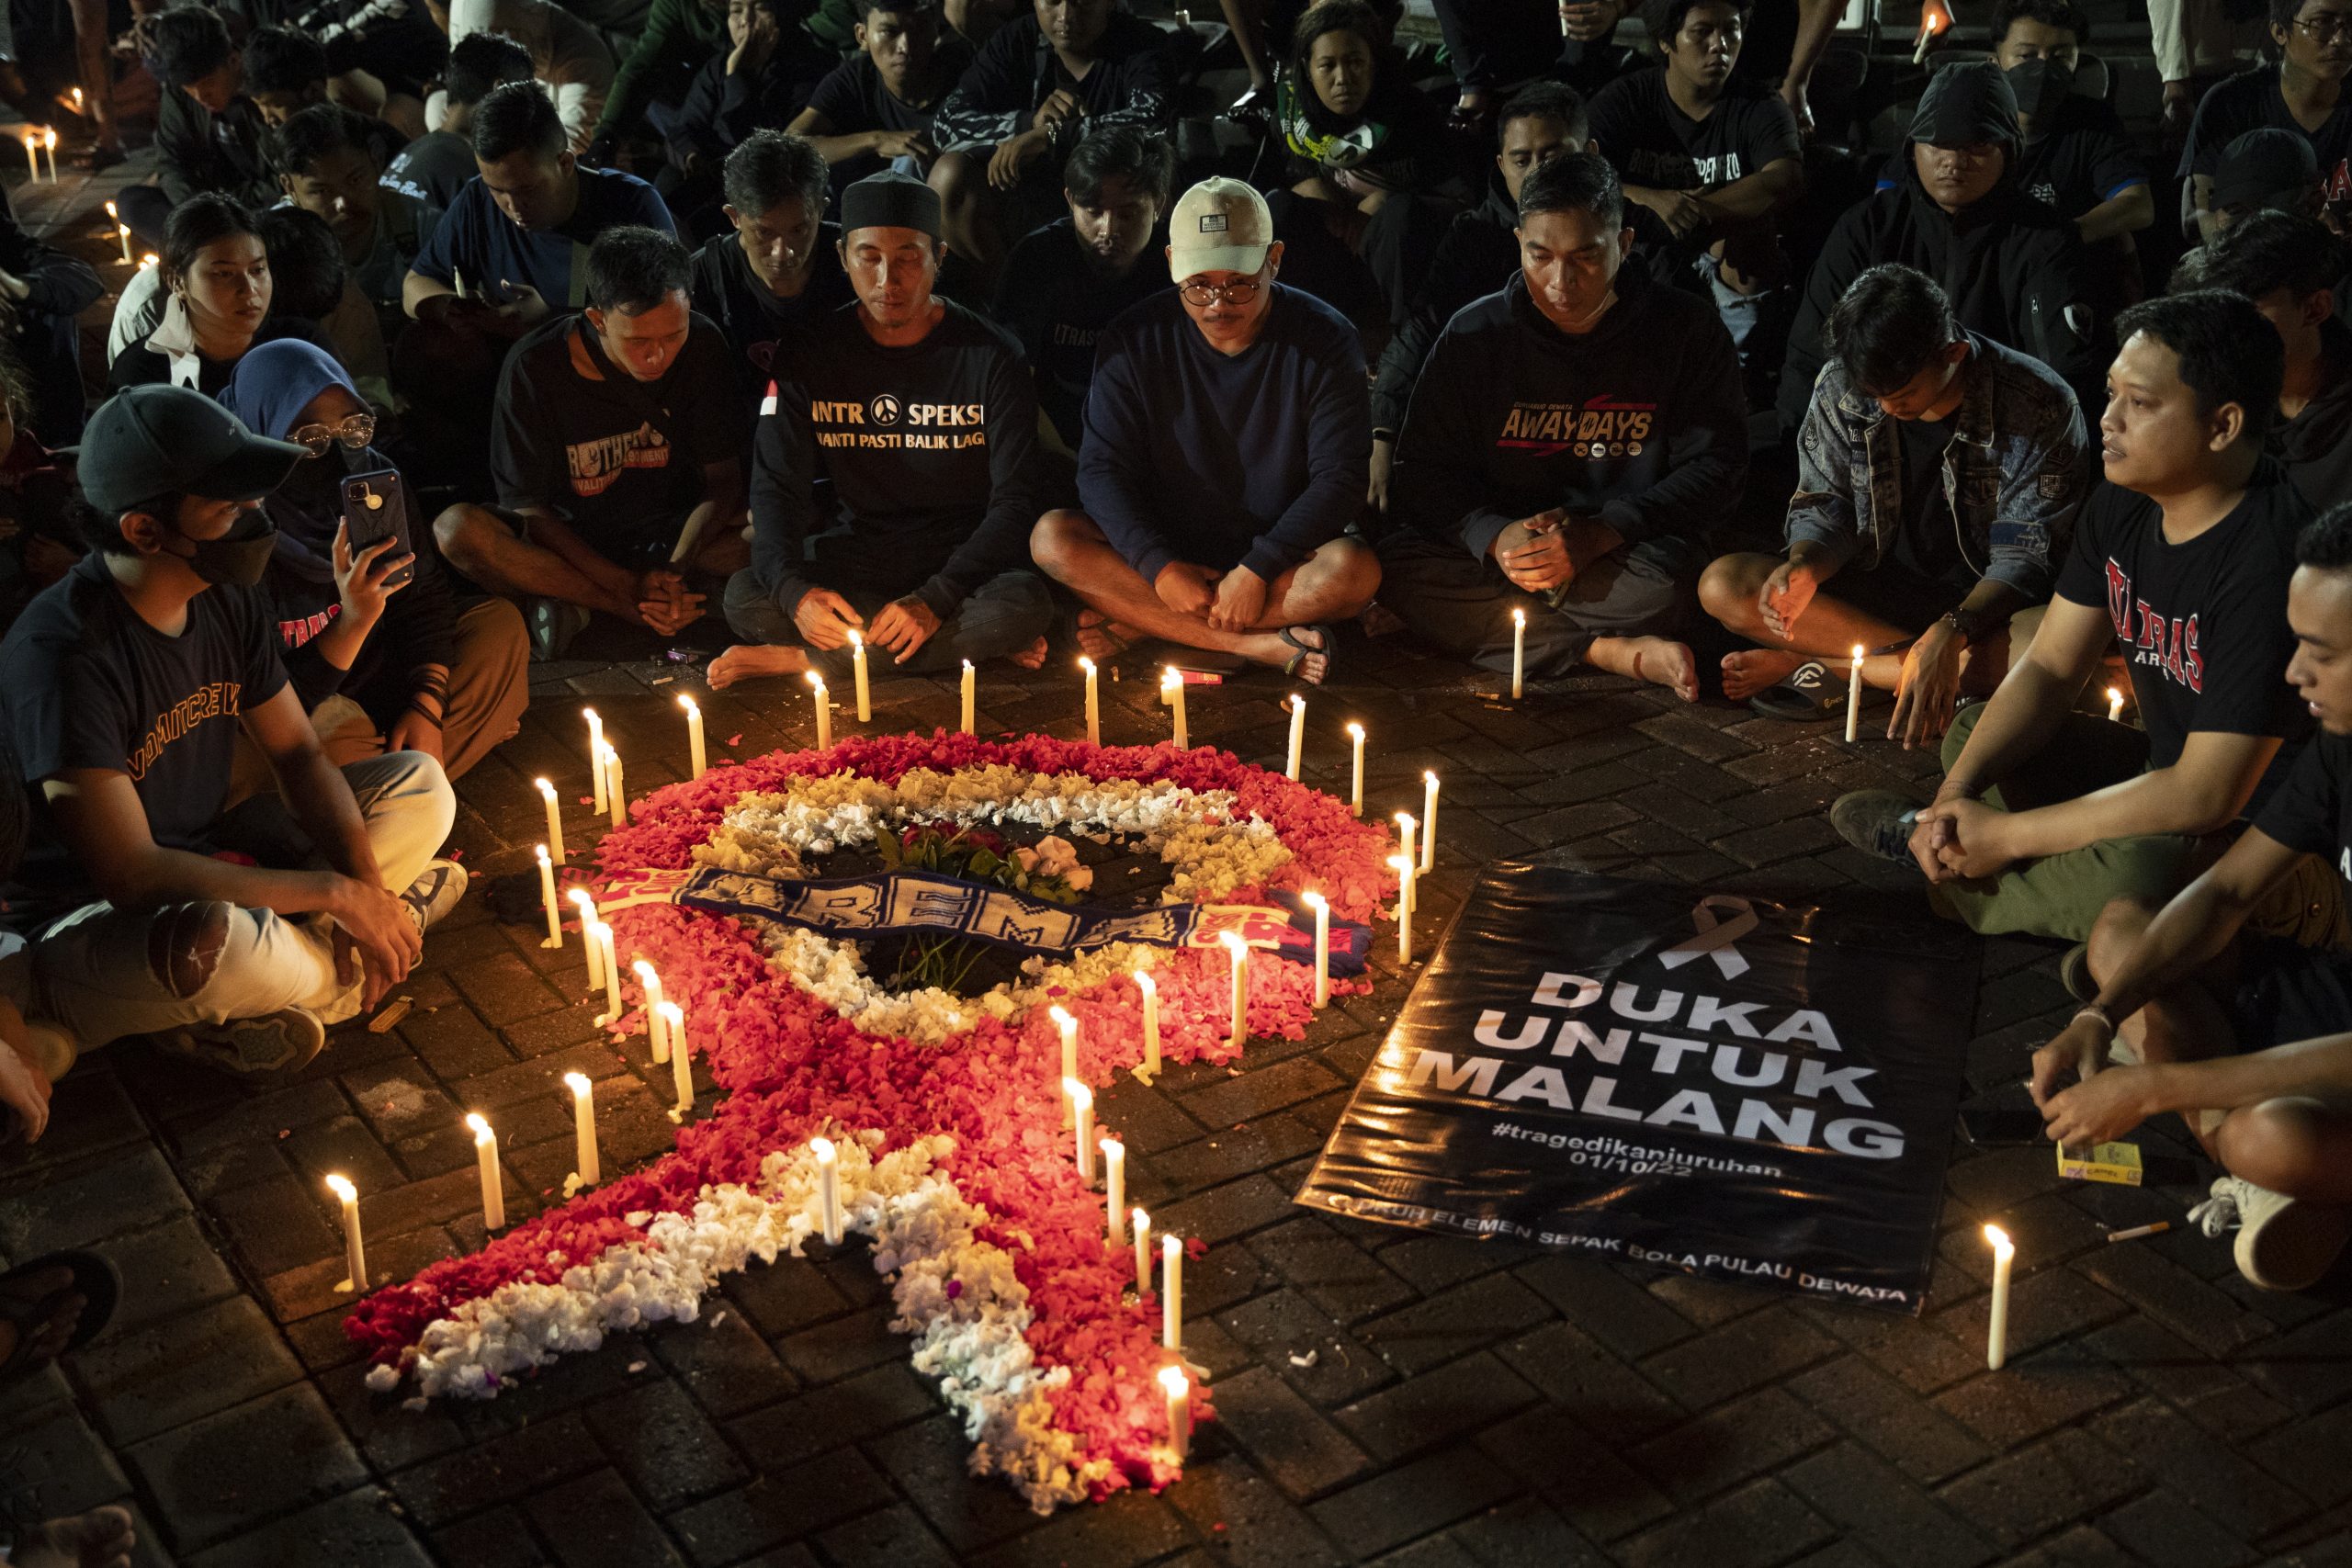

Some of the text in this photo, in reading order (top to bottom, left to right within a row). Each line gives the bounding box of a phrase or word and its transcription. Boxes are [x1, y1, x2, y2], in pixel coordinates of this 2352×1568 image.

[812, 400, 865, 424] INTR
[859, 433, 901, 448] PASTI
[905, 433, 950, 449] BALIK
[689, 873, 1174, 952] AREMA
[1531, 972, 1842, 1052] DUKA
[1473, 1010, 1878, 1108] UNTUK
[1408, 1050, 1905, 1159] MALANG
[1491, 1122, 1781, 1178] #tragedikanjuruhan
[1569, 1151, 1692, 1177] 01/10/22
[1432, 1210, 1532, 1238] ELEMEN
[1538, 1231, 1622, 1251] SEPAK
[1628, 1244, 1698, 1267] BOLA
[1704, 1254, 1792, 1280] PULAU
[1798, 1273, 1907, 1303] DEWATA
